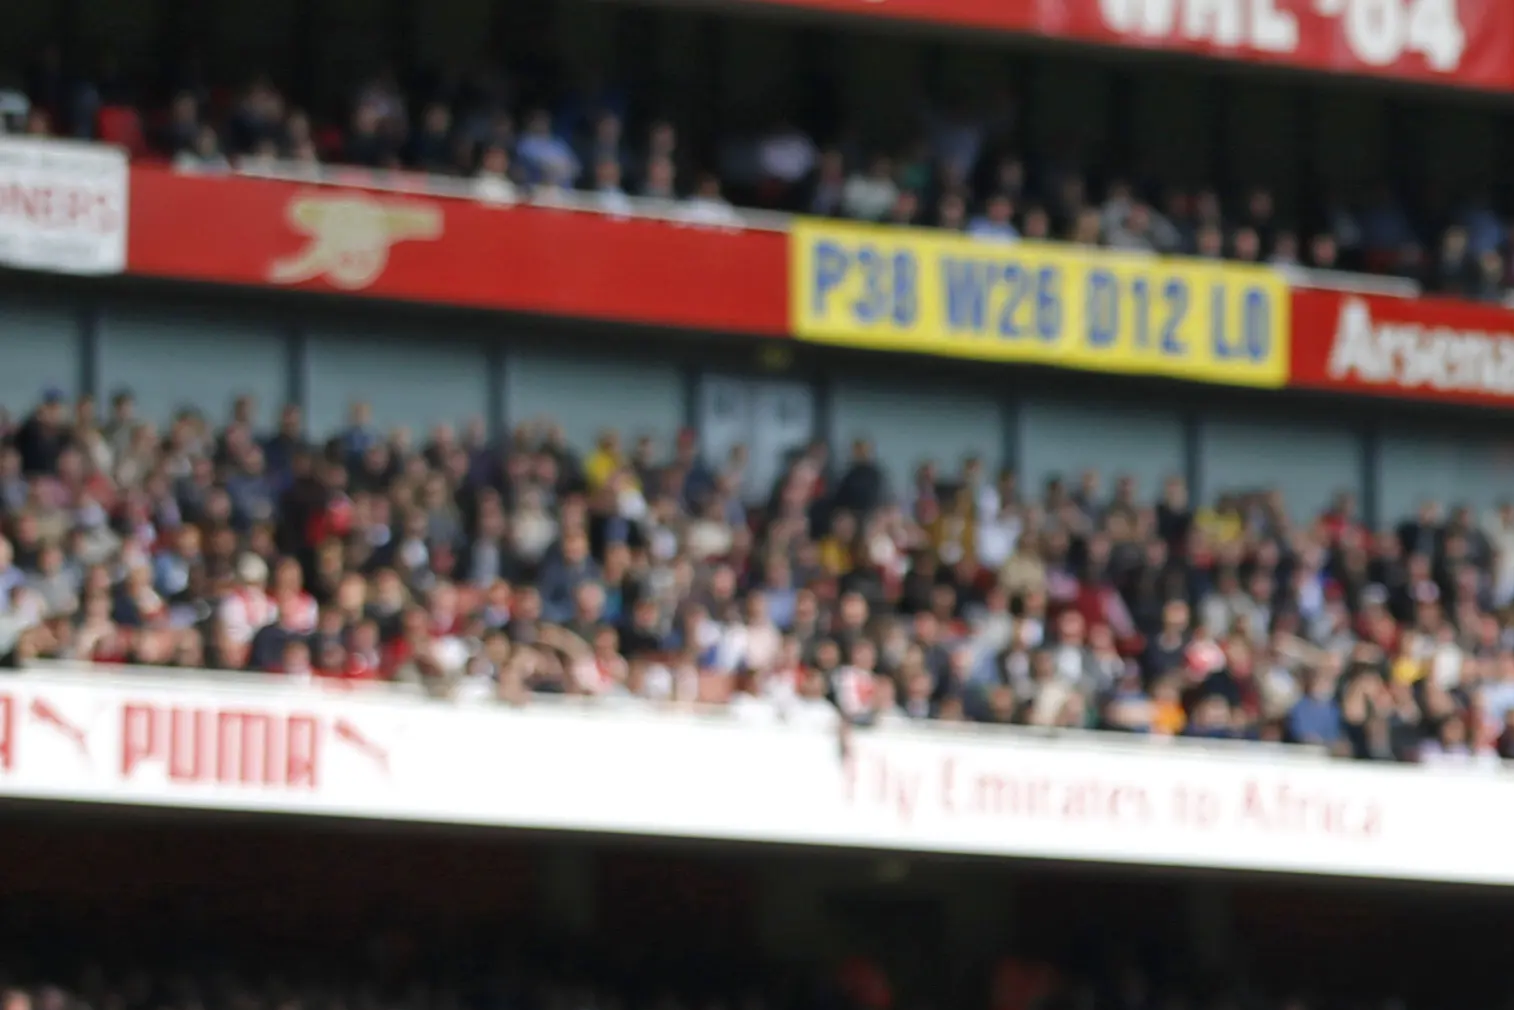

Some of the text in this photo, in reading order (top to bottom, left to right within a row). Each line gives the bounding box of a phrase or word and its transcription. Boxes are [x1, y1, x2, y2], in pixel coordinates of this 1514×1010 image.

[811, 240, 918, 330] P38
[940, 256, 1063, 343] W26
[1084, 268, 1188, 356] D12
[120, 702, 322, 788] PUMA
[941, 752, 1157, 828] Emirates
[1241, 779, 1384, 838] Africa
